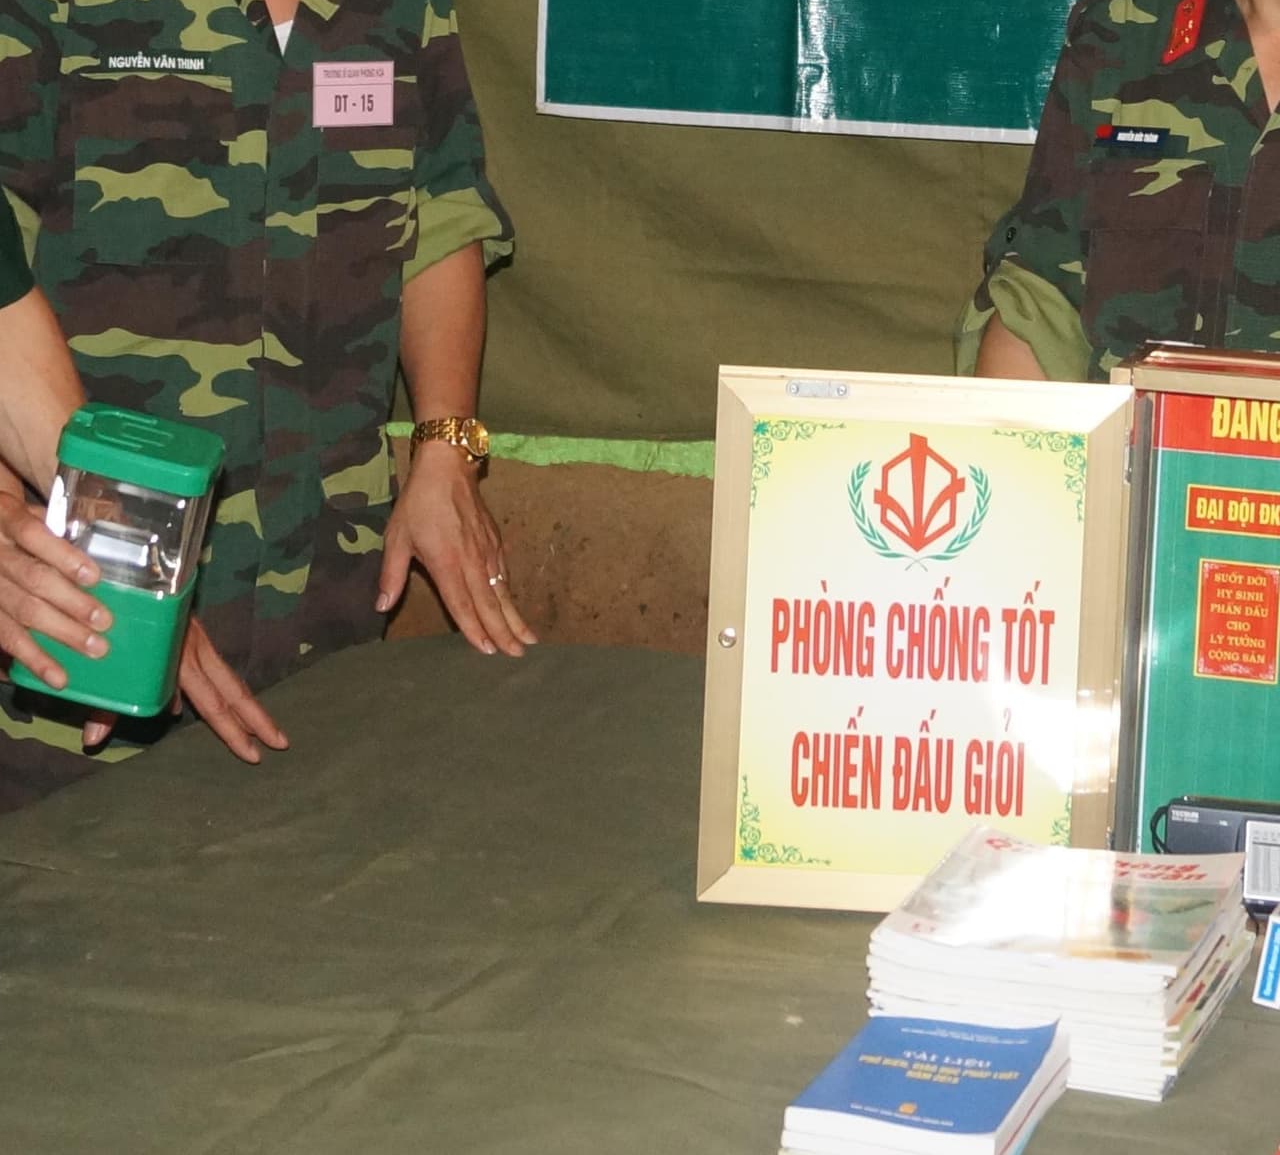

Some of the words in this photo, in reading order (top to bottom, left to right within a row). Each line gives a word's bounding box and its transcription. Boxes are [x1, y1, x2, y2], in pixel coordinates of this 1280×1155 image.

[108, 51, 151, 68] NGUYỄN
[153, 54, 176, 68] VĂN
[334, 94, 349, 113] DT
[361, 94, 374, 112] 15
[1196, 496, 1223, 525] ĐẠI
[1227, 496, 1256, 528] ĐỘI
[1216, 588, 1232, 599] HY
[1236, 591, 1264, 602] SINH
[770, 579, 875, 679] PHÒNG
[886, 576, 991, 683] CHỐNG
[1001, 580, 1055, 685] TỐT
[1226, 621, 1251, 632] CHO
[790, 705, 883, 811] CHIẾN
[892, 709, 955, 814] ĐẤU
[964, 707, 1026, 818] GIỎI
